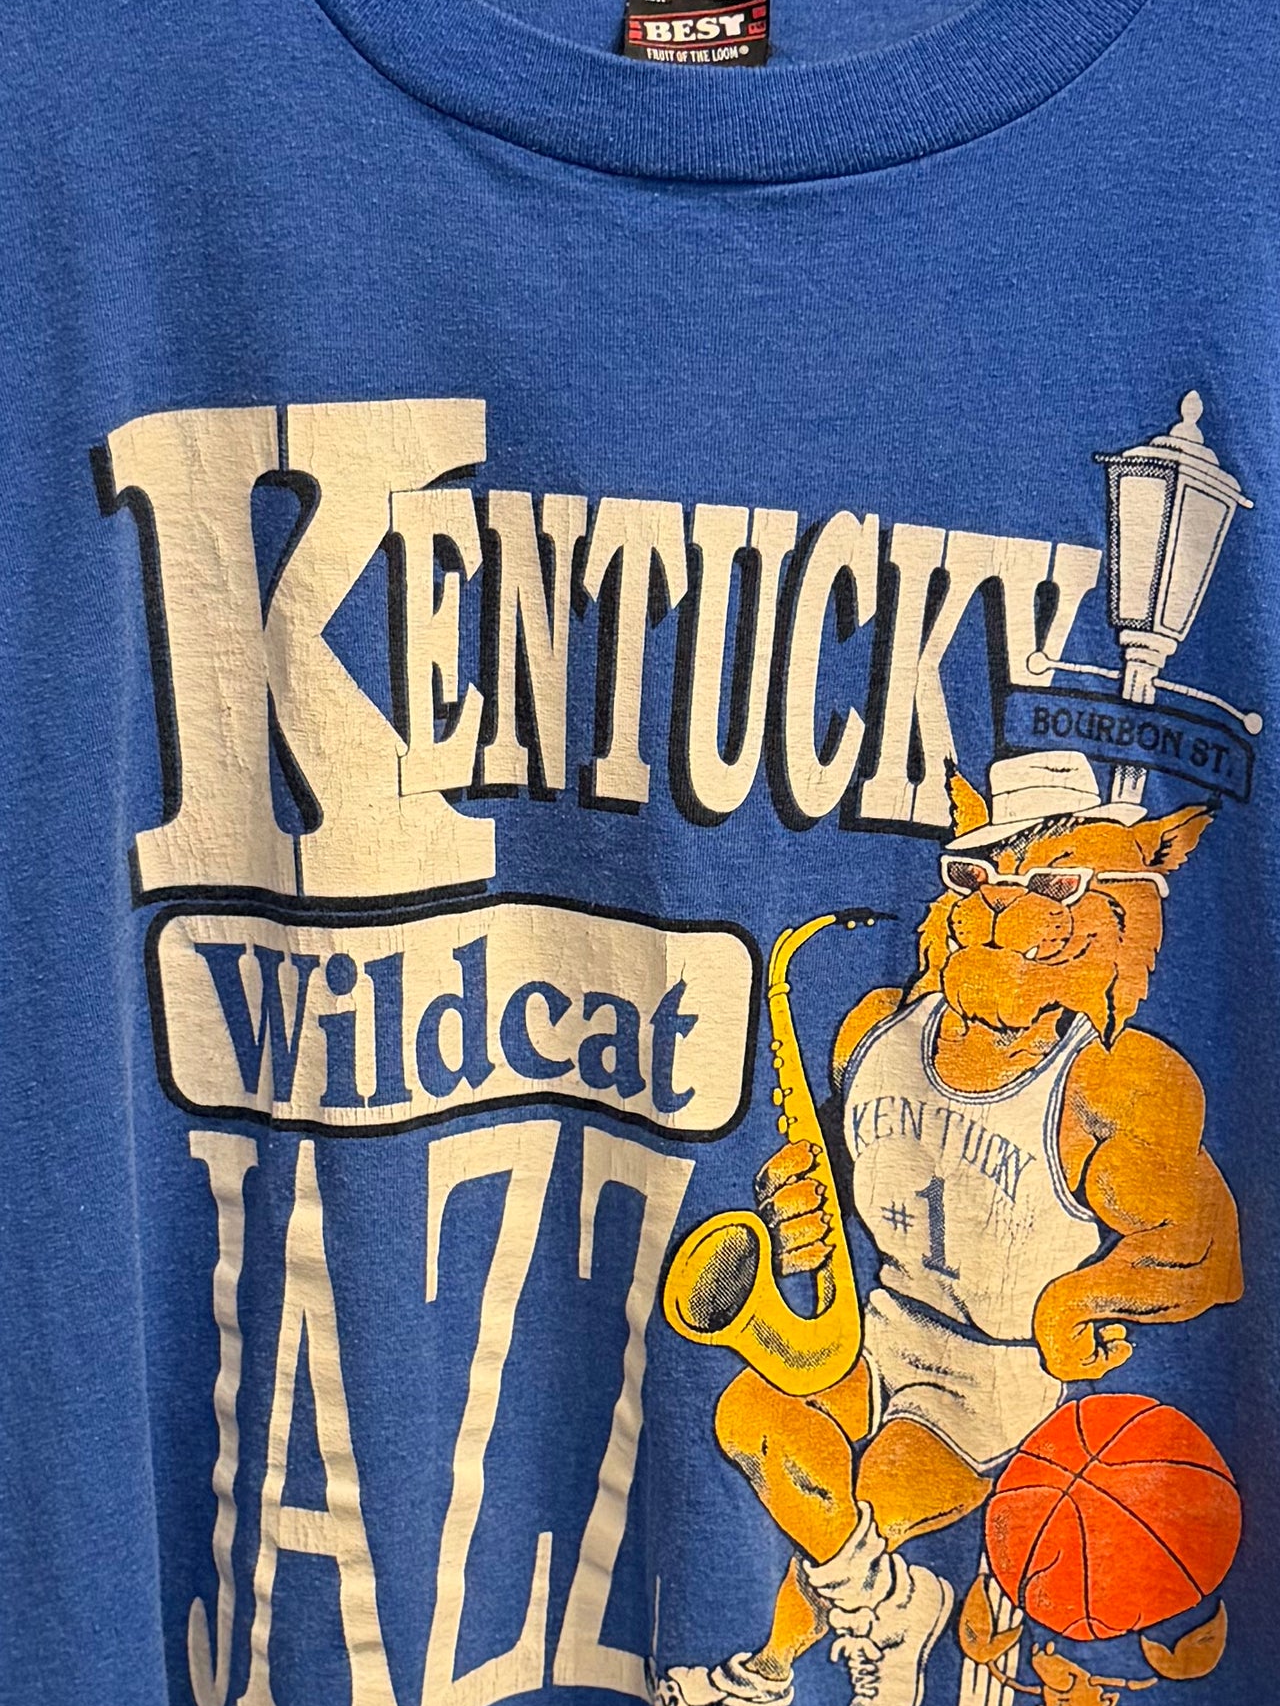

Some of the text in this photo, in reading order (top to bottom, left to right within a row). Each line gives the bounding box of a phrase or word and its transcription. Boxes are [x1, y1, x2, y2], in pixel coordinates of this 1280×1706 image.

[643, 13, 745, 43] BEST
[646, 45, 739, 63] FRUIT OF THE LOOM
[91, 398, 1102, 905] KENTUCKY
[1032, 705, 1184, 759] BOURBON
[195, 935, 699, 1114] Wildcat
[851, 1095, 1037, 1204] KENTUCKY
